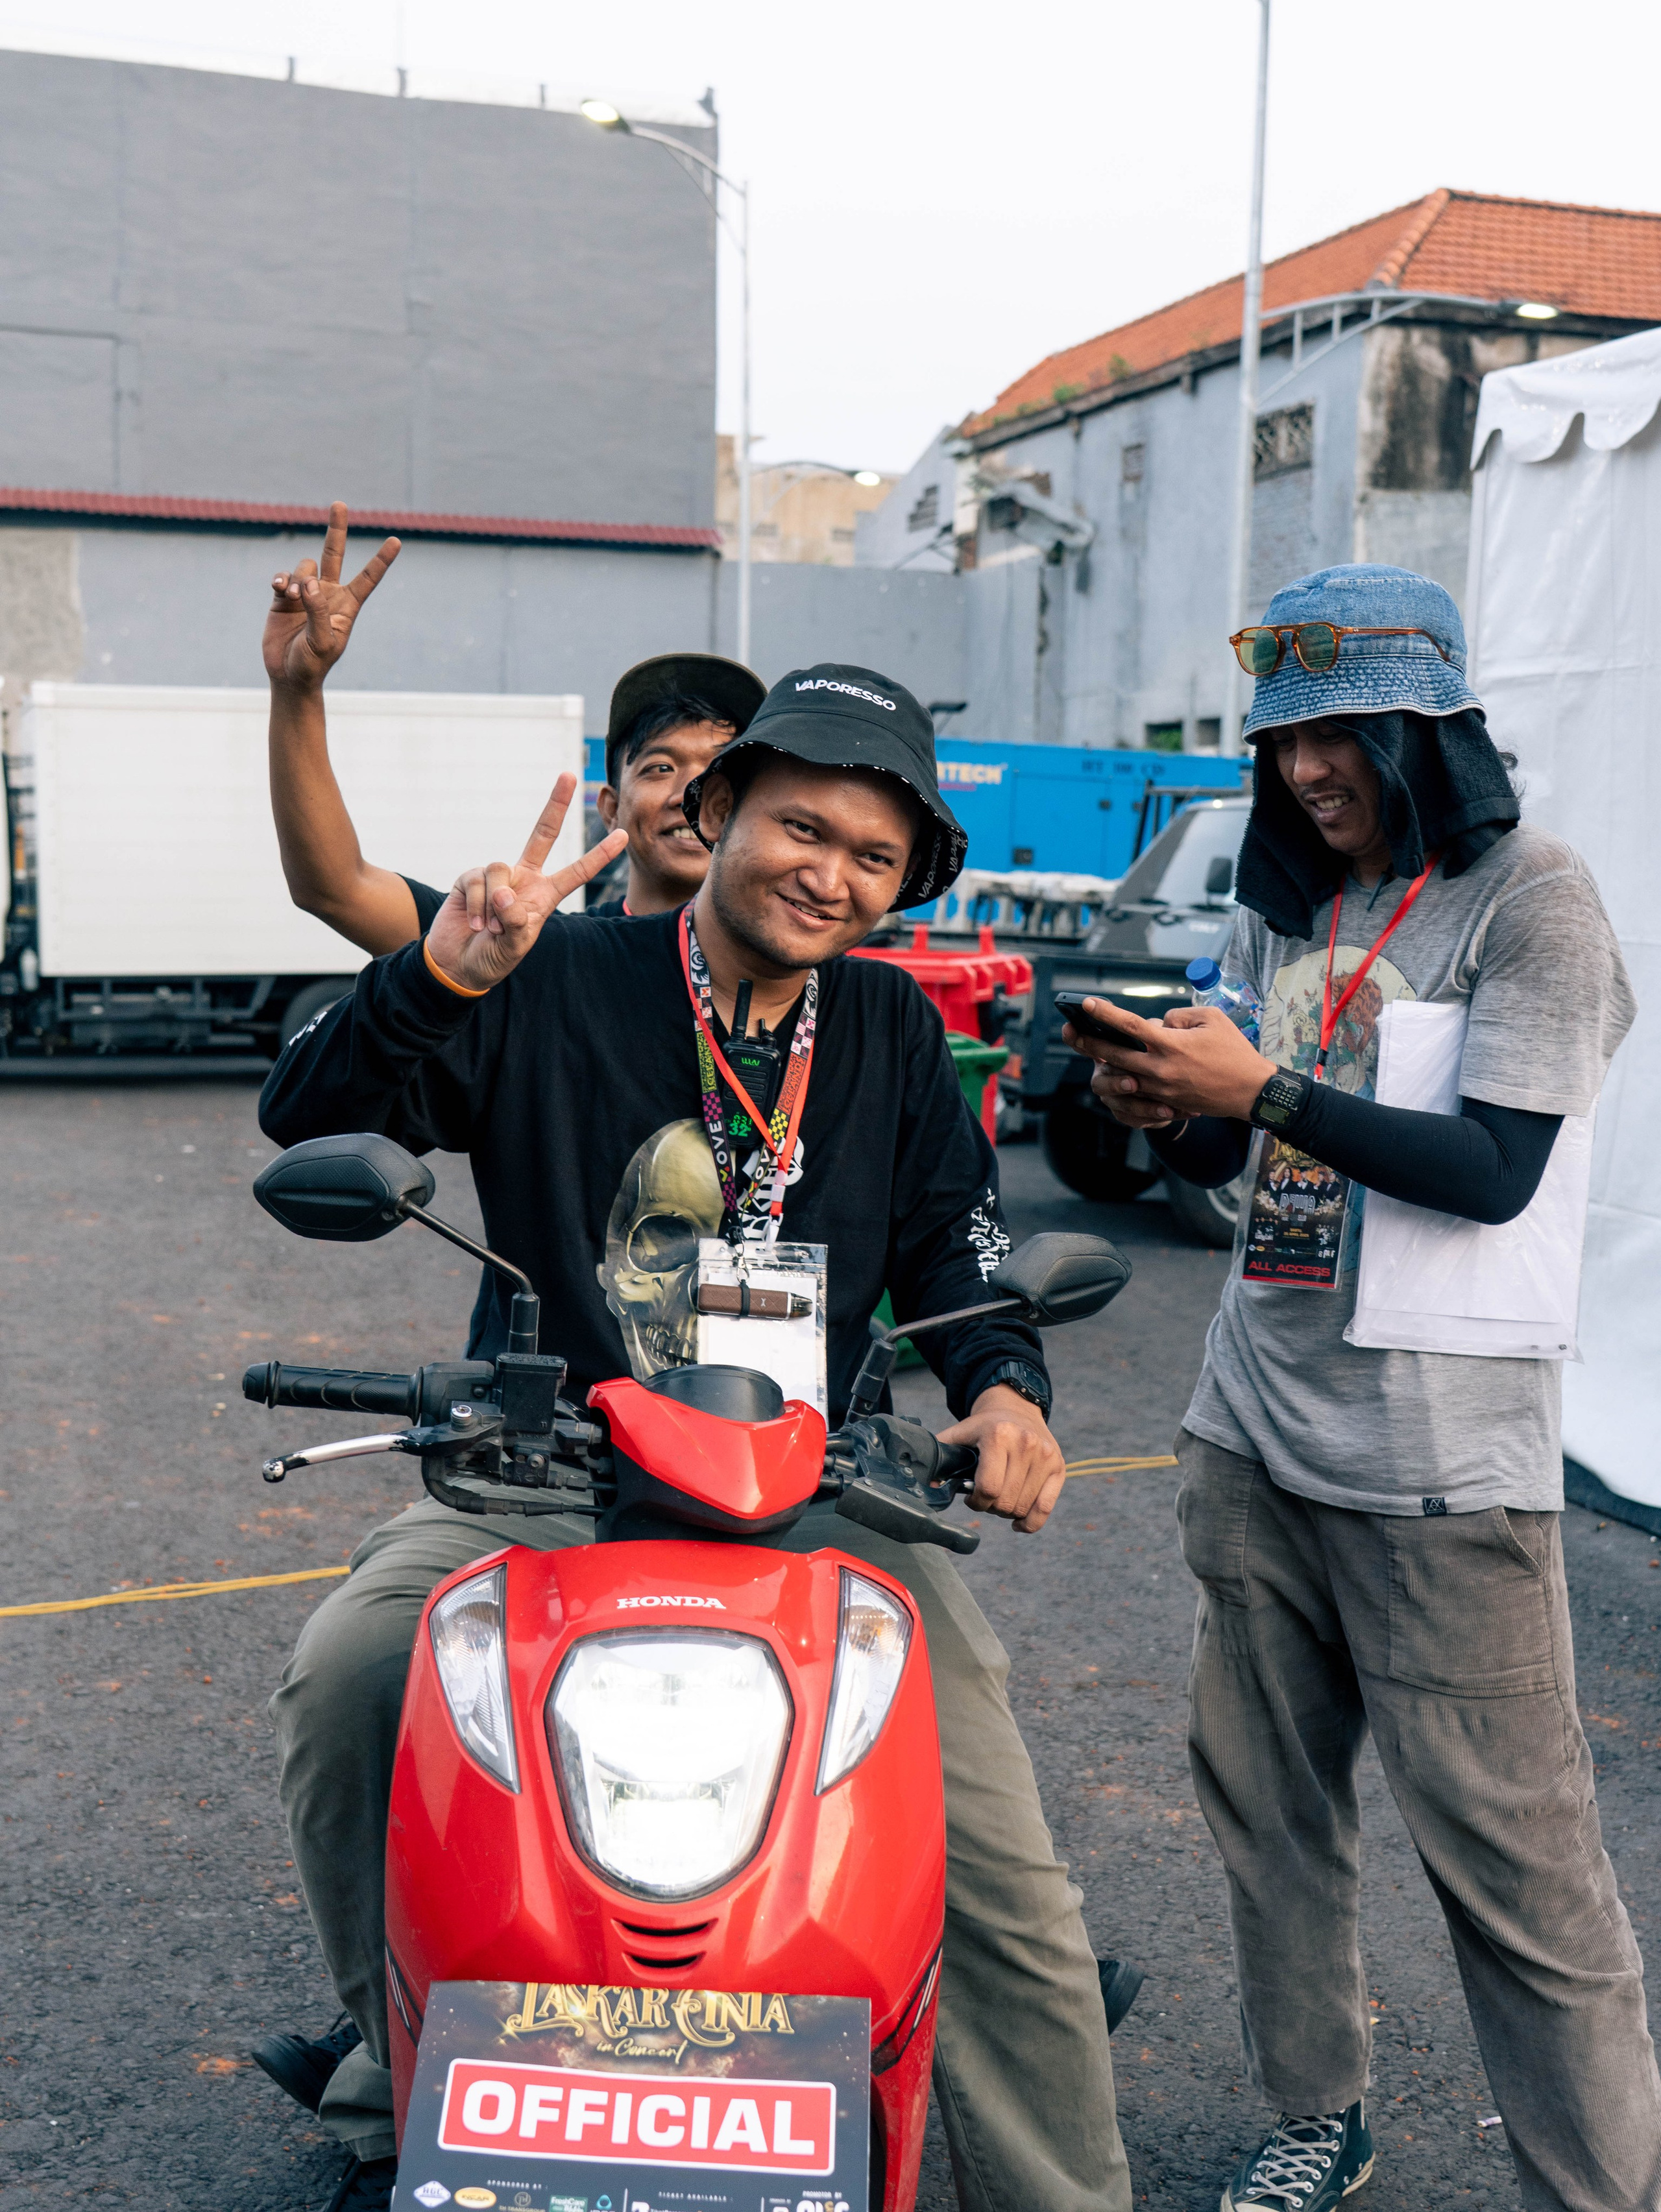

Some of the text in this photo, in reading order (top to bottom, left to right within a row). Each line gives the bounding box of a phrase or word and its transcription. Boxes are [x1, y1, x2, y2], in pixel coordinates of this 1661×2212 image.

[795, 679, 897, 712] VAPORESSO
[1248, 1261, 1331, 1277] ALL ACCESS
[617, 1596, 727, 1609] HONDA
[507, 1982, 670, 2038] LASKAR
[596, 2037, 689, 2065] in Concert
[461, 2080, 815, 2156] OFFICIAL
[487, 2180, 530, 2189] SPONSORED
[686, 2193, 727, 2202] AVAILABLE
[802, 2190, 832, 2198] PROMOTOR
